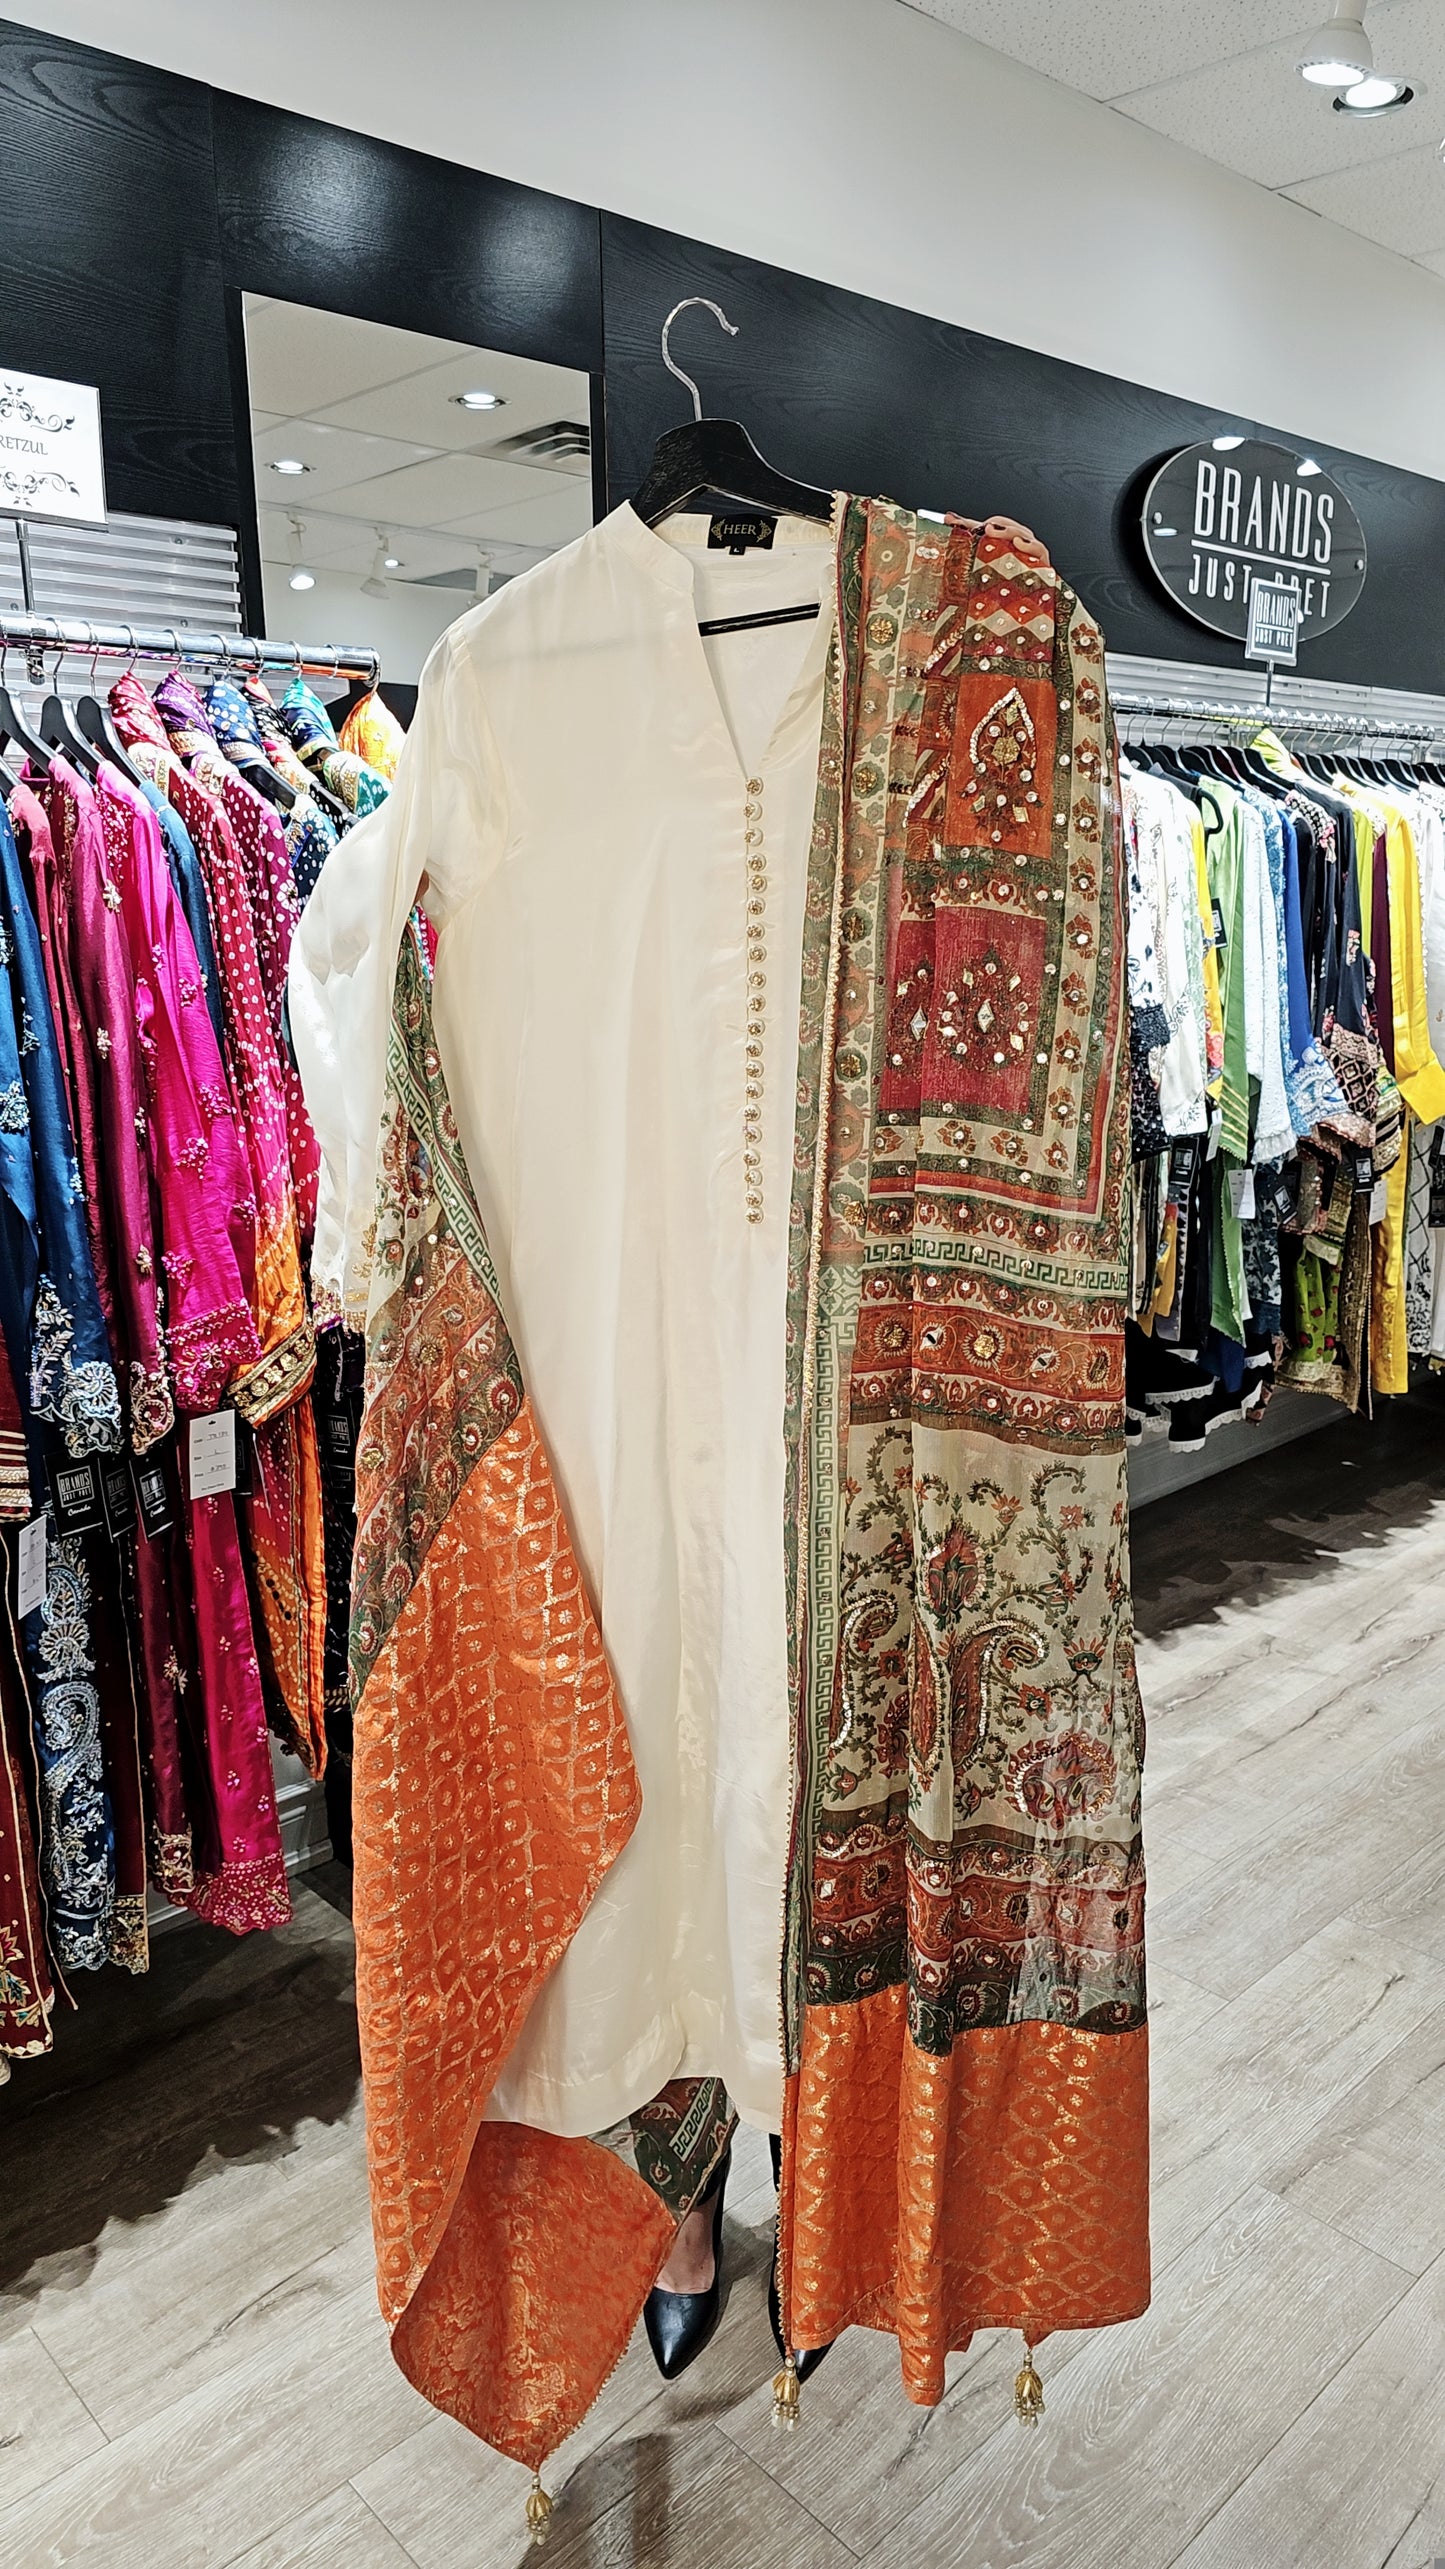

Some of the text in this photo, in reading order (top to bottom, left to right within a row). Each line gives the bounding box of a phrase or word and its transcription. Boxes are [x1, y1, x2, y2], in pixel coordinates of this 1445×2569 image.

[723, 524, 757, 535] HEER
[1194, 459, 1334, 564] BRANDS
[1188, 554, 1252, 604] JUST
[1256, 591, 1296, 628] BRANDS
[1255, 627, 1293, 648] JUST PRET
